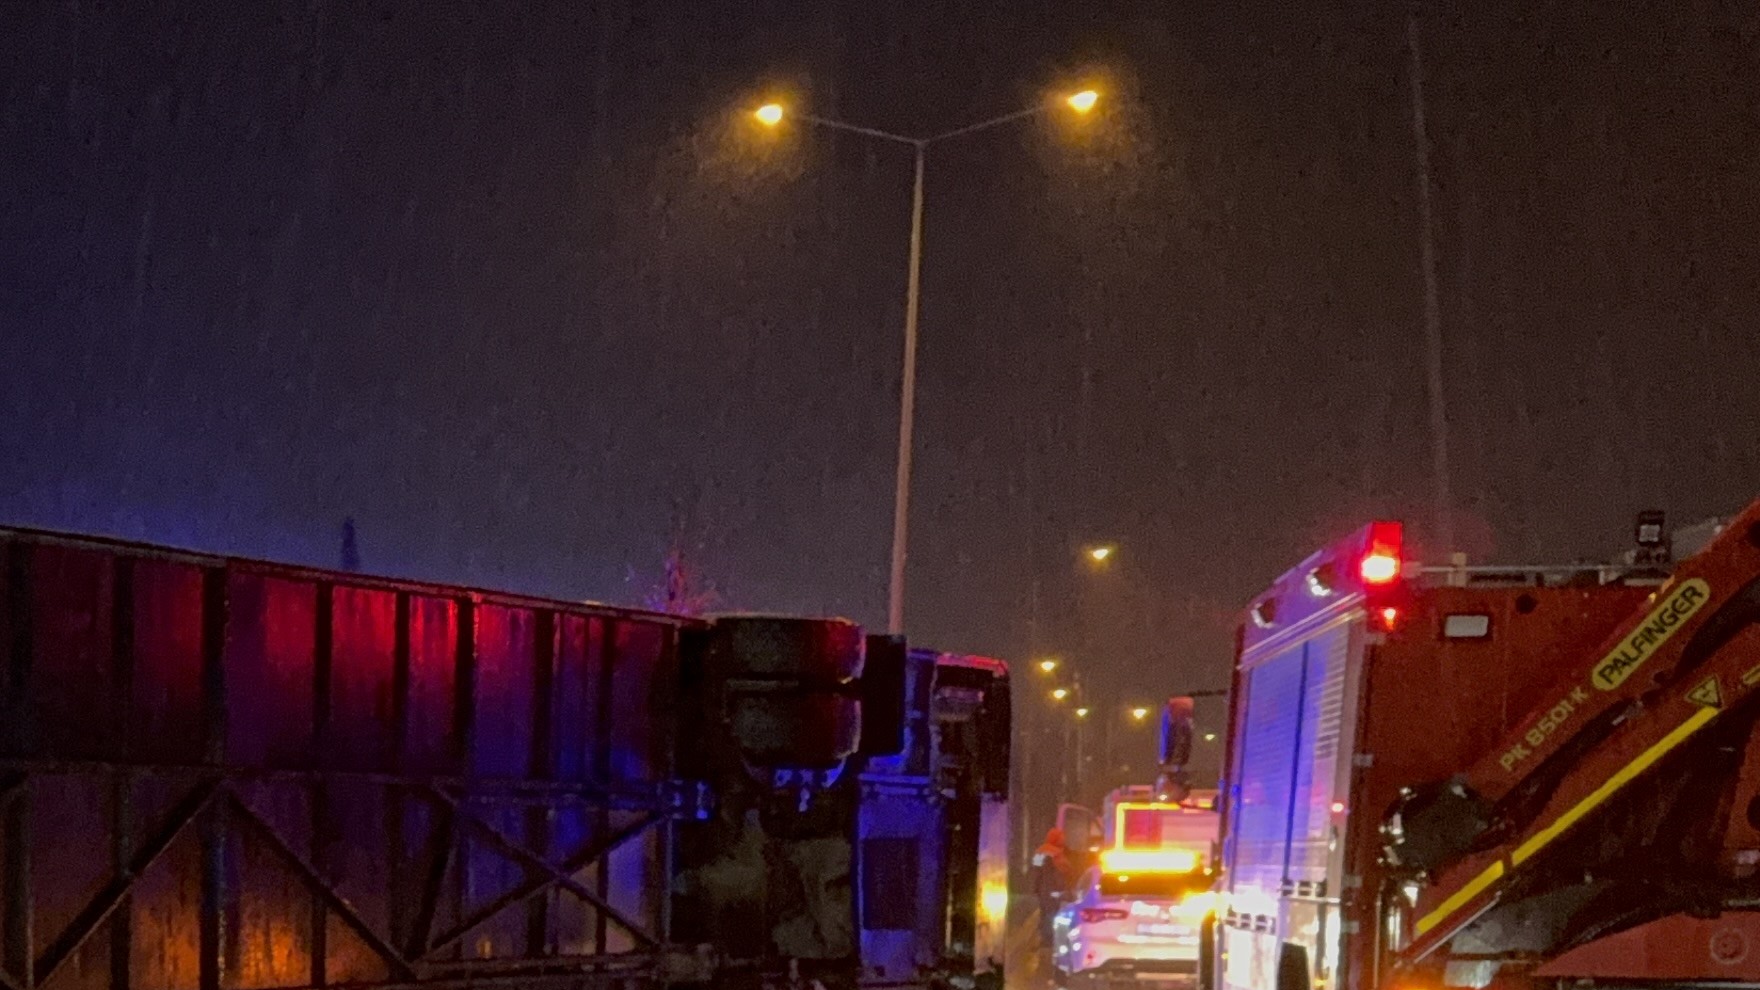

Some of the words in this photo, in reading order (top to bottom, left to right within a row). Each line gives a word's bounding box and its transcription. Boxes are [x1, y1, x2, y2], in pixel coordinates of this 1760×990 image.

[1598, 585, 1705, 684] PALFINGER
[1499, 743, 1532, 772] PK
[1525, 699, 1575, 747] 8501
[1571, 686, 1589, 699] K
